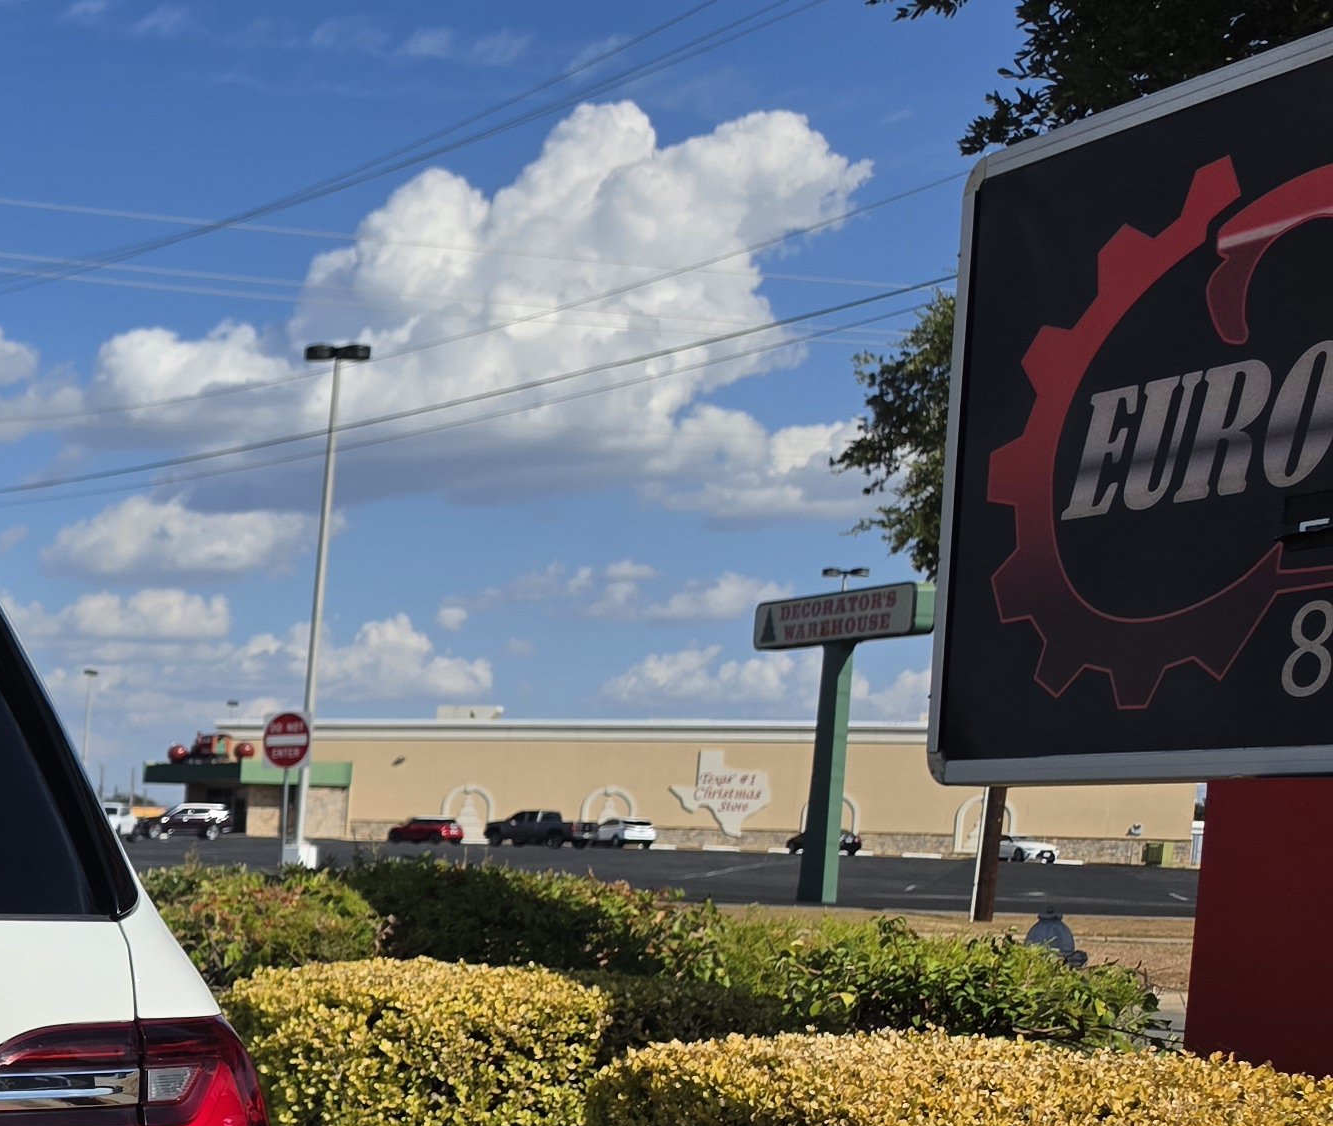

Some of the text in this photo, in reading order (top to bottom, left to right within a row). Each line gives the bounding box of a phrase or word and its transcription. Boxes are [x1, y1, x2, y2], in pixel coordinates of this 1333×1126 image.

[1061, 340, 1333, 521] EURO
[780, 590, 897, 622] DECORATOR'S
[784, 613, 891, 641] WAREHOUSE
[269, 722, 283, 734] DO
[272, 747, 300, 759] ENTER
[739, 773, 757, 786] #1
[694, 786, 763, 801] Christmas
[717, 801, 750, 813] Store
